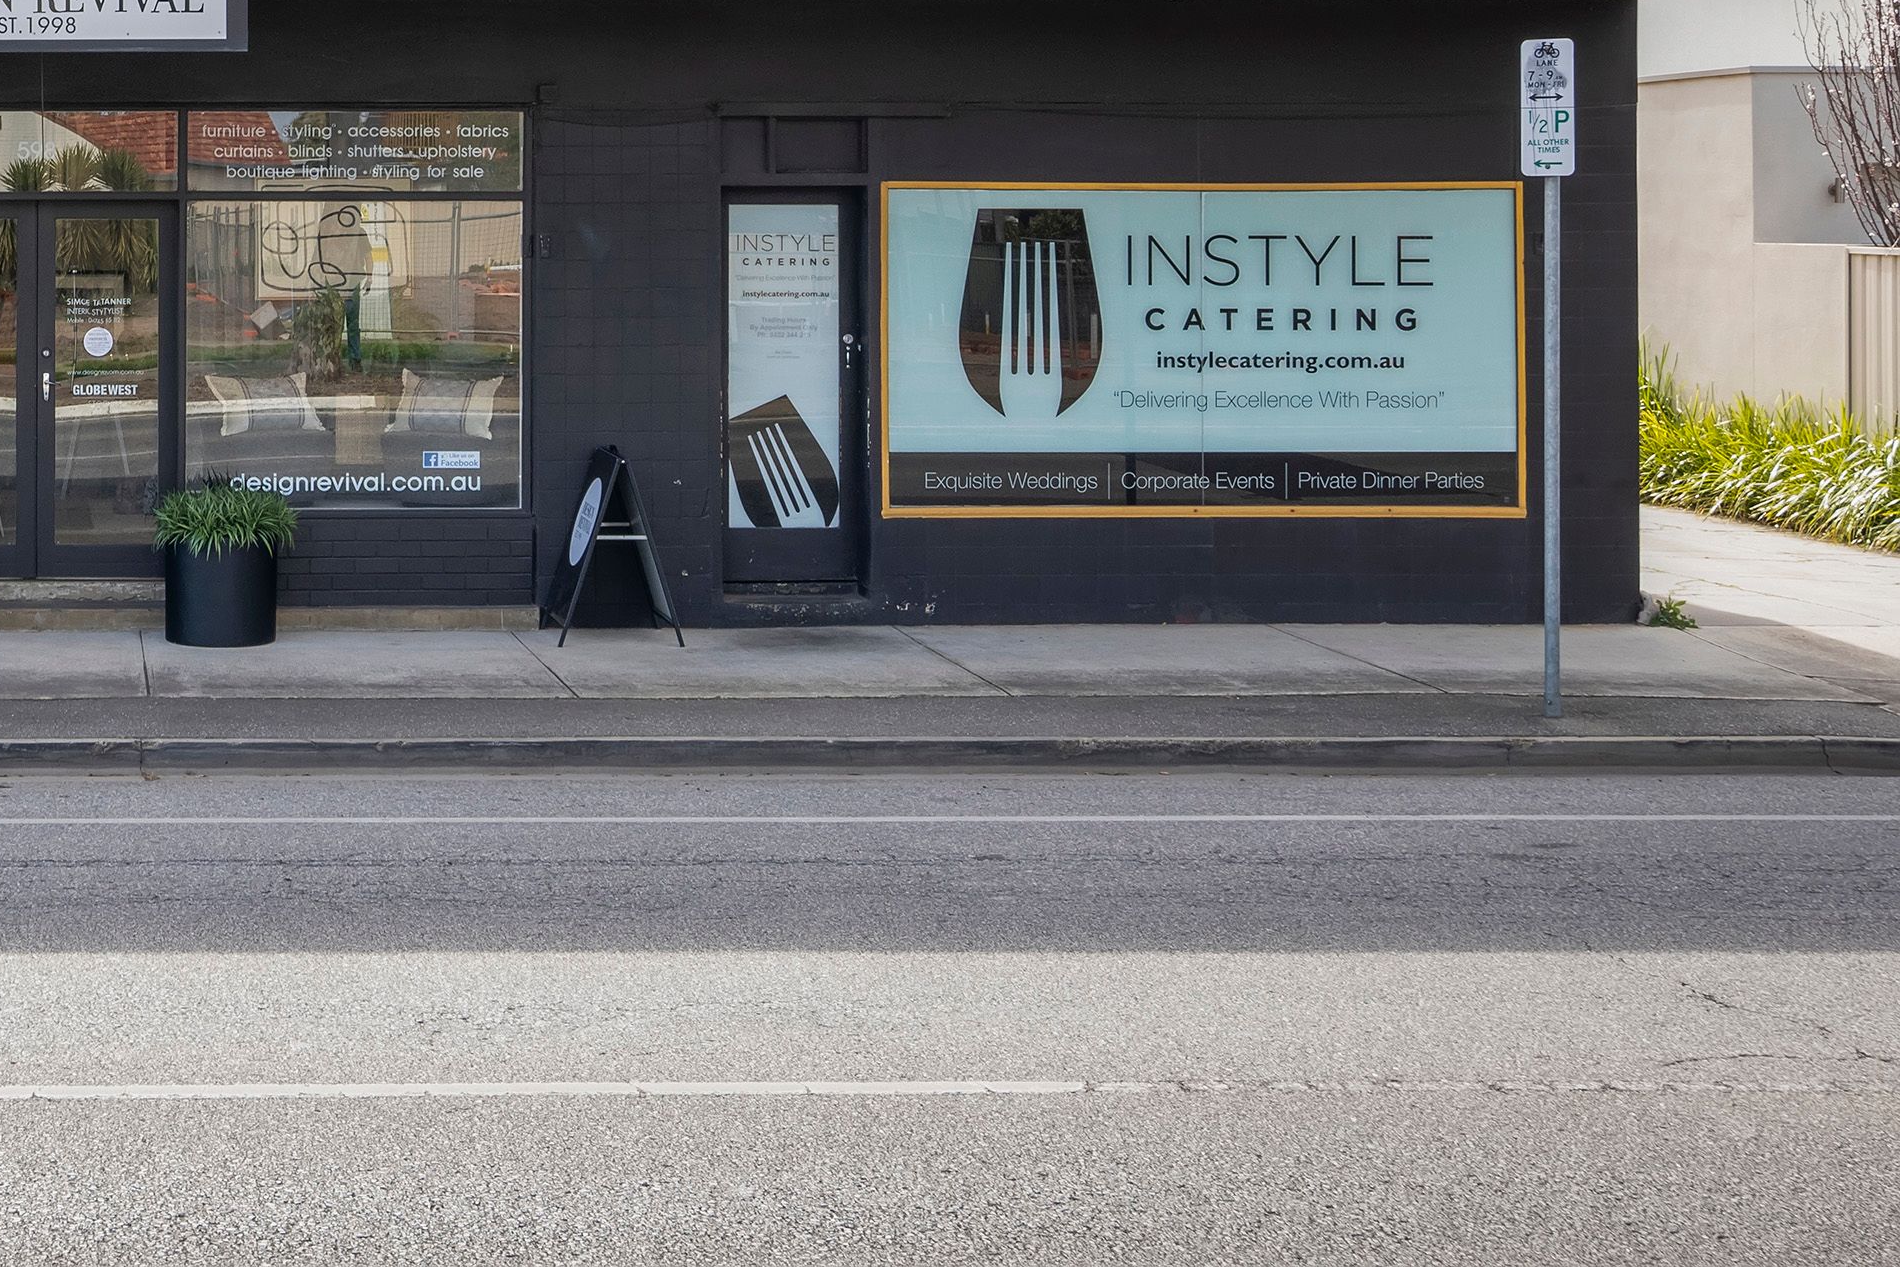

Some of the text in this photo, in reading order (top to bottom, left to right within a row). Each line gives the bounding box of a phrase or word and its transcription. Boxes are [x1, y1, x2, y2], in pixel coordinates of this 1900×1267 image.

[202, 124, 509, 140] furniture styling accessories fabrics
[214, 144, 496, 161] curtains blinds shutters upholstery
[226, 164, 484, 180] boutique lighting styling for sale
[737, 234, 835, 252] INSTYLE
[742, 258, 830, 266] CATERING
[1126, 234, 1434, 287] INSTYLE
[742, 291, 829, 299] instylecatering.com.au
[1144, 308, 1418, 332] CATERING
[1156, 351, 1405, 372] instylecatering.com.au
[73, 384, 138, 395] GLOBEWEST
[1214, 390, 1313, 408] Excellence
[1318, 390, 1360, 408] With
[230, 472, 481, 496] designrevival.com.au
[924, 471, 1484, 494] Exquisite Weddings Corporate Events Private Dinner Parties
